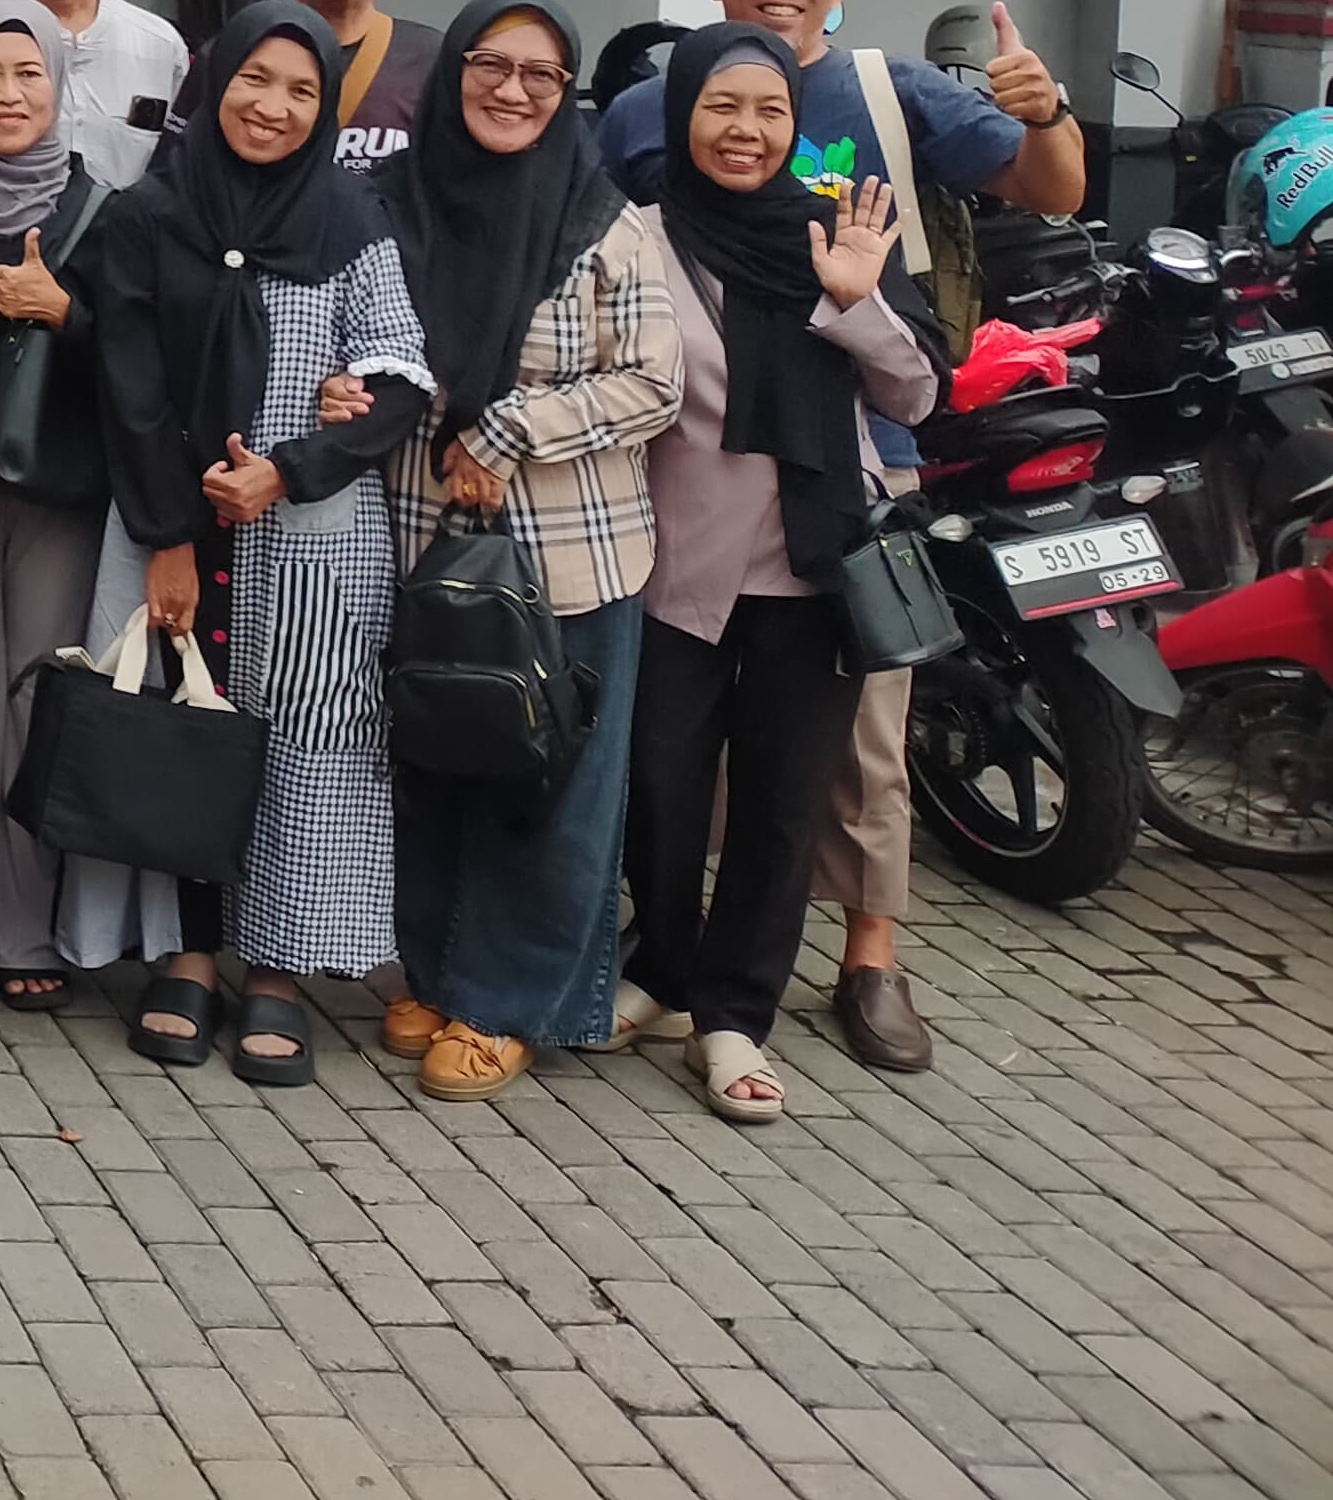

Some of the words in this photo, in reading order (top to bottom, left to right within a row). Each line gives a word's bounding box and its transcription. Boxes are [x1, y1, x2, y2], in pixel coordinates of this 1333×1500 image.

[343, 159, 372, 170] FOR
[1025, 501, 1073, 518] HONDA
[1005, 555, 1023, 579] S
[1038, 539, 1101, 572] 5919
[1120, 529, 1151, 555] ST
